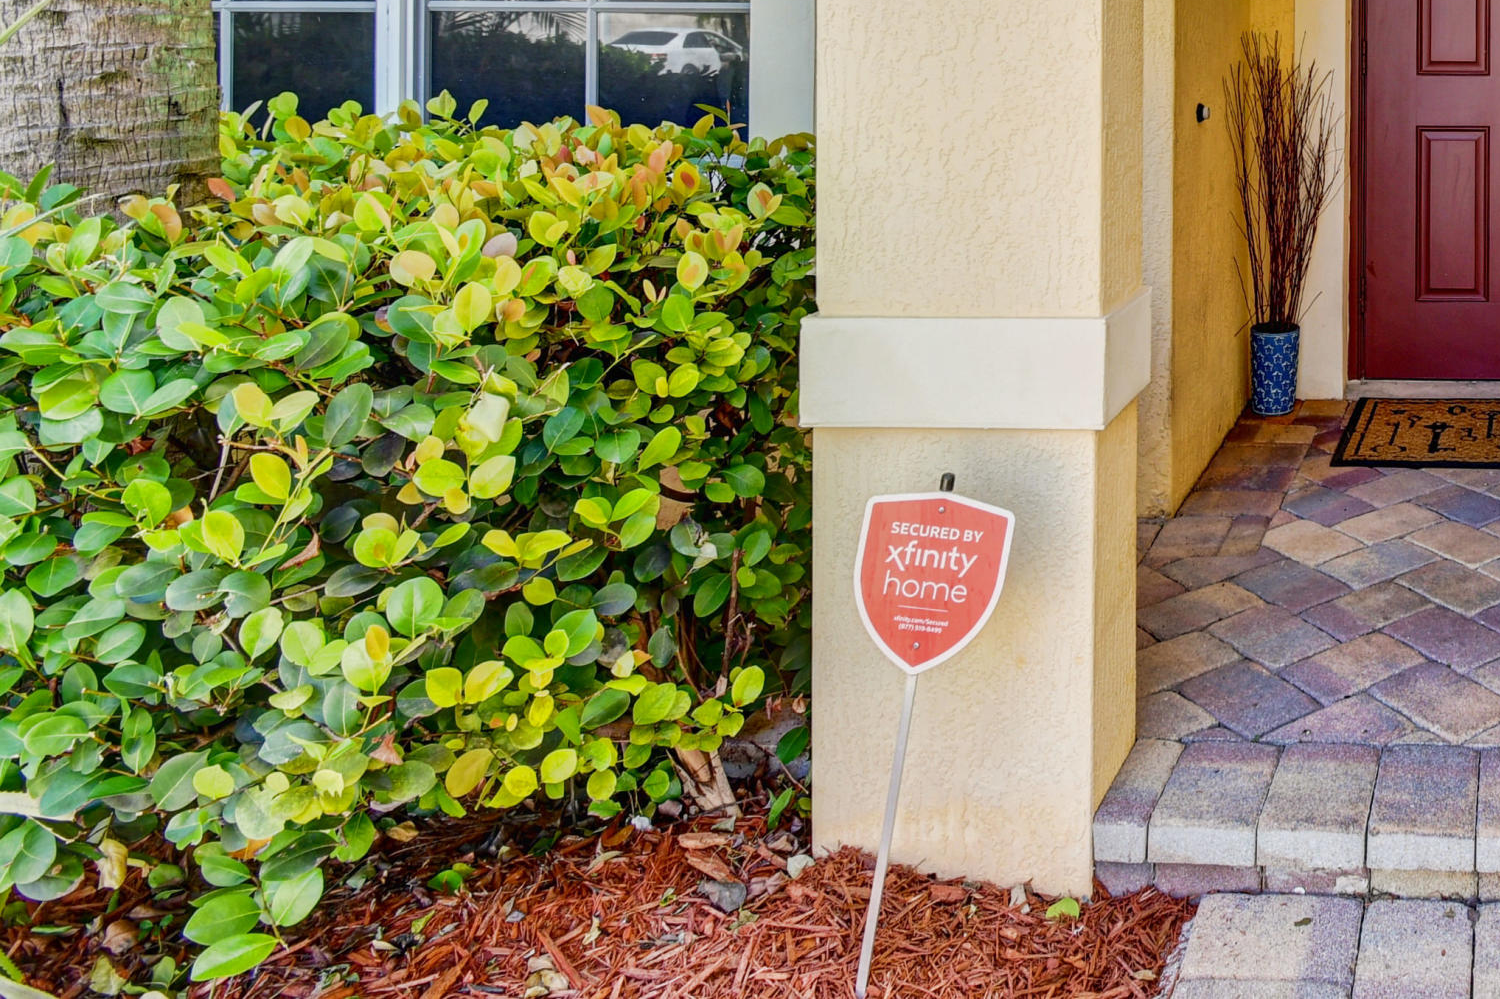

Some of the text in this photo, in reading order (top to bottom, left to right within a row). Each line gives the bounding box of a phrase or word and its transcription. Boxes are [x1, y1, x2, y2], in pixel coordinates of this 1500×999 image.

[891, 521, 983, 542] SECURED BY
[885, 540, 978, 578] xfinity
[882, 569, 967, 603] home
